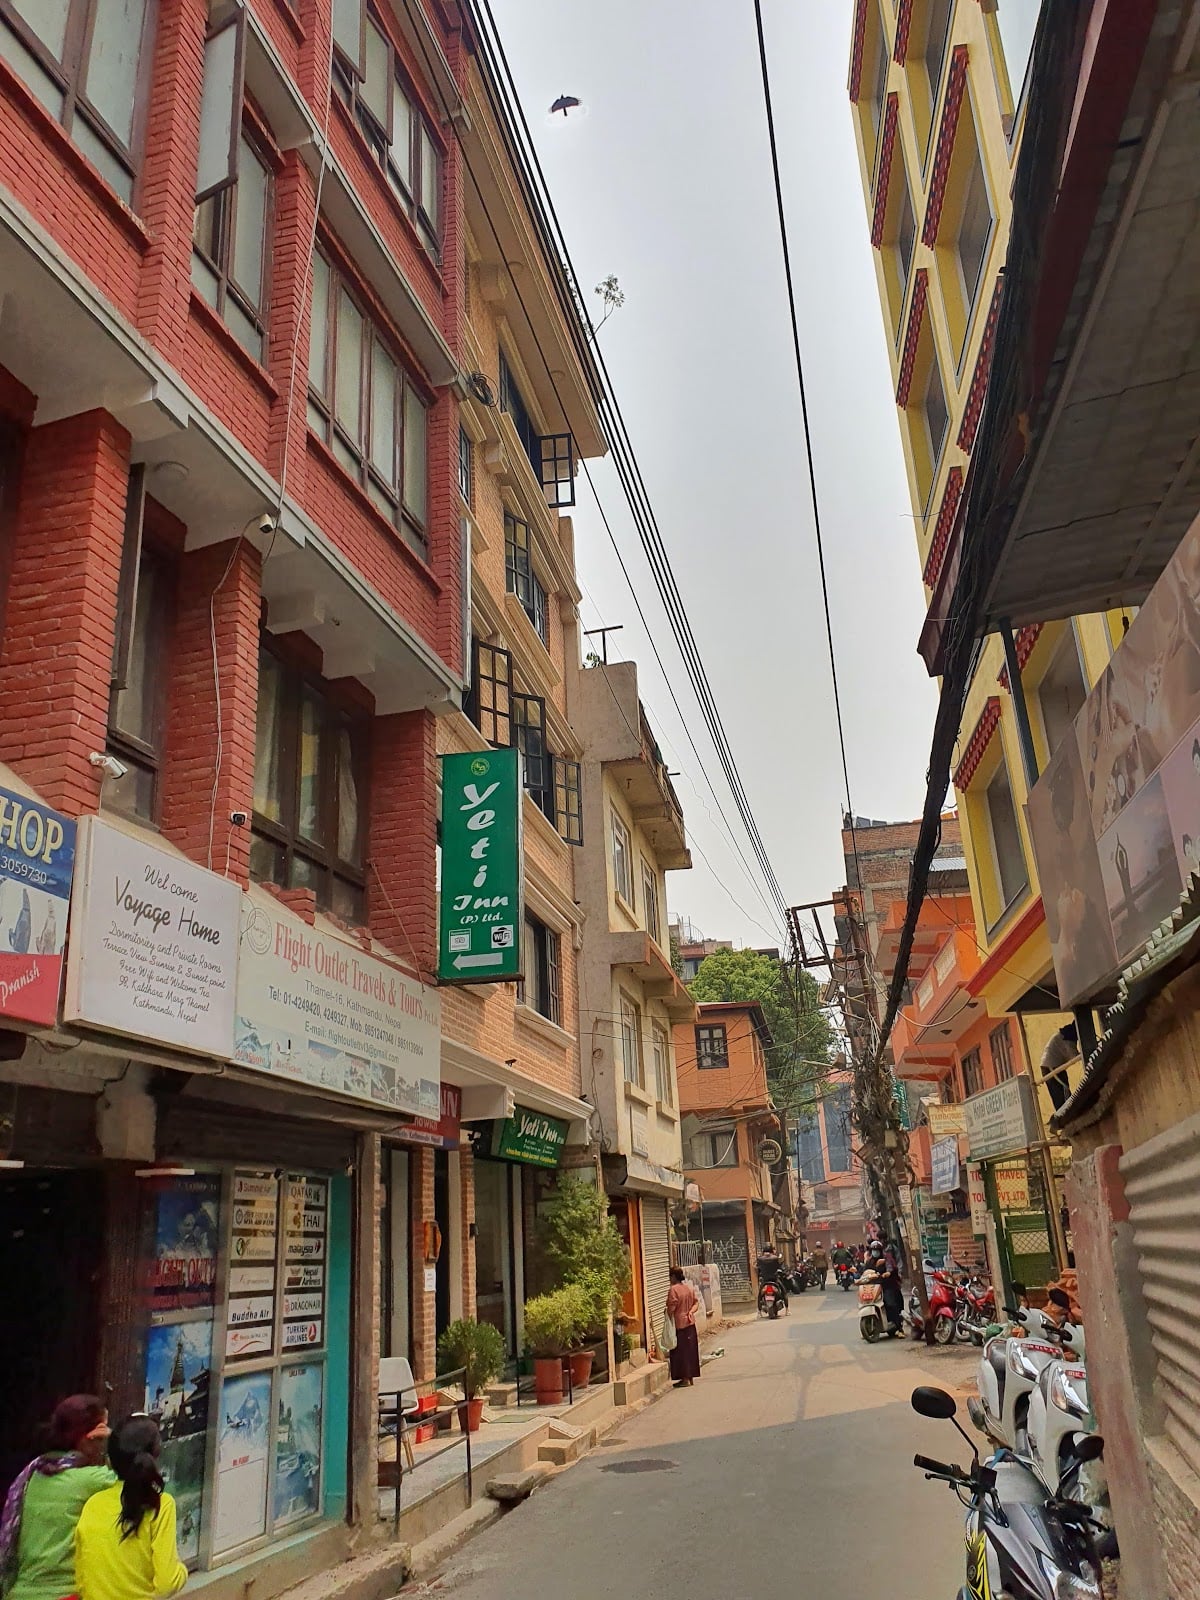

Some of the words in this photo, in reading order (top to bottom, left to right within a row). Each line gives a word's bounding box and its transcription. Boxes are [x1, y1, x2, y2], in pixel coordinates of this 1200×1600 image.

[115, 875, 171, 933] Voyage
[178, 907, 220, 945] Home
[453, 894, 509, 911] Inn
[157, 943, 172, 956] and
[172, 945, 198, 964] Private
[103, 937, 129, 956] Terrace
[129, 947, 148, 962] View
[149, 955, 176, 972] Sunrise
[185, 967, 209, 984] Sunset
[209, 977, 226, 989] point
[273, 922, 312, 973] Flight
[314, 941, 349, 986] Outlet
[351, 959, 386, 1005] Travels
[388, 978, 397, 1008] &
[399, 983, 423, 1020] Tours
[119, 959, 137, 974] Free
[155, 974, 169, 985] and
[170, 975, 198, 994] Welcome
[199, 986, 210, 998] Tea
[165, 989, 184, 1008] Marg
[186, 996, 210, 1012] Thamel
[268, 986, 282, 1000] Tel:
[132, 995, 175, 1018] Kathmandu,
[177, 1009, 198, 1023] Nepal
[304, 979, 344, 1006] Thamel-16,
[346, 997, 384, 1021] Kathmandu,
[385, 1012, 401, 1030] Nepa
[305, 1021, 327, 1039] E-mail:
[985, 1091, 1003, 1115] GREEN
[517, 1114, 540, 1138] Yeti
[540, 1120, 558, 1143] Inn
[290, 1186, 313, 1199] QATAR
[302, 1214, 320, 1228] THAI
[288, 1244, 313, 1256] malaysia
[302, 1277, 321, 1286] Airlines
[303, 1267, 319, 1279] Nepal
[290, 1300, 321, 1312] DRAGONAIR
[231, 1310, 258, 1322] Buddha
[259, 1309, 270, 1318] Air
[286, 1325, 308, 1334] TURKISH
[285, 1334, 308, 1344] AIRLINES
